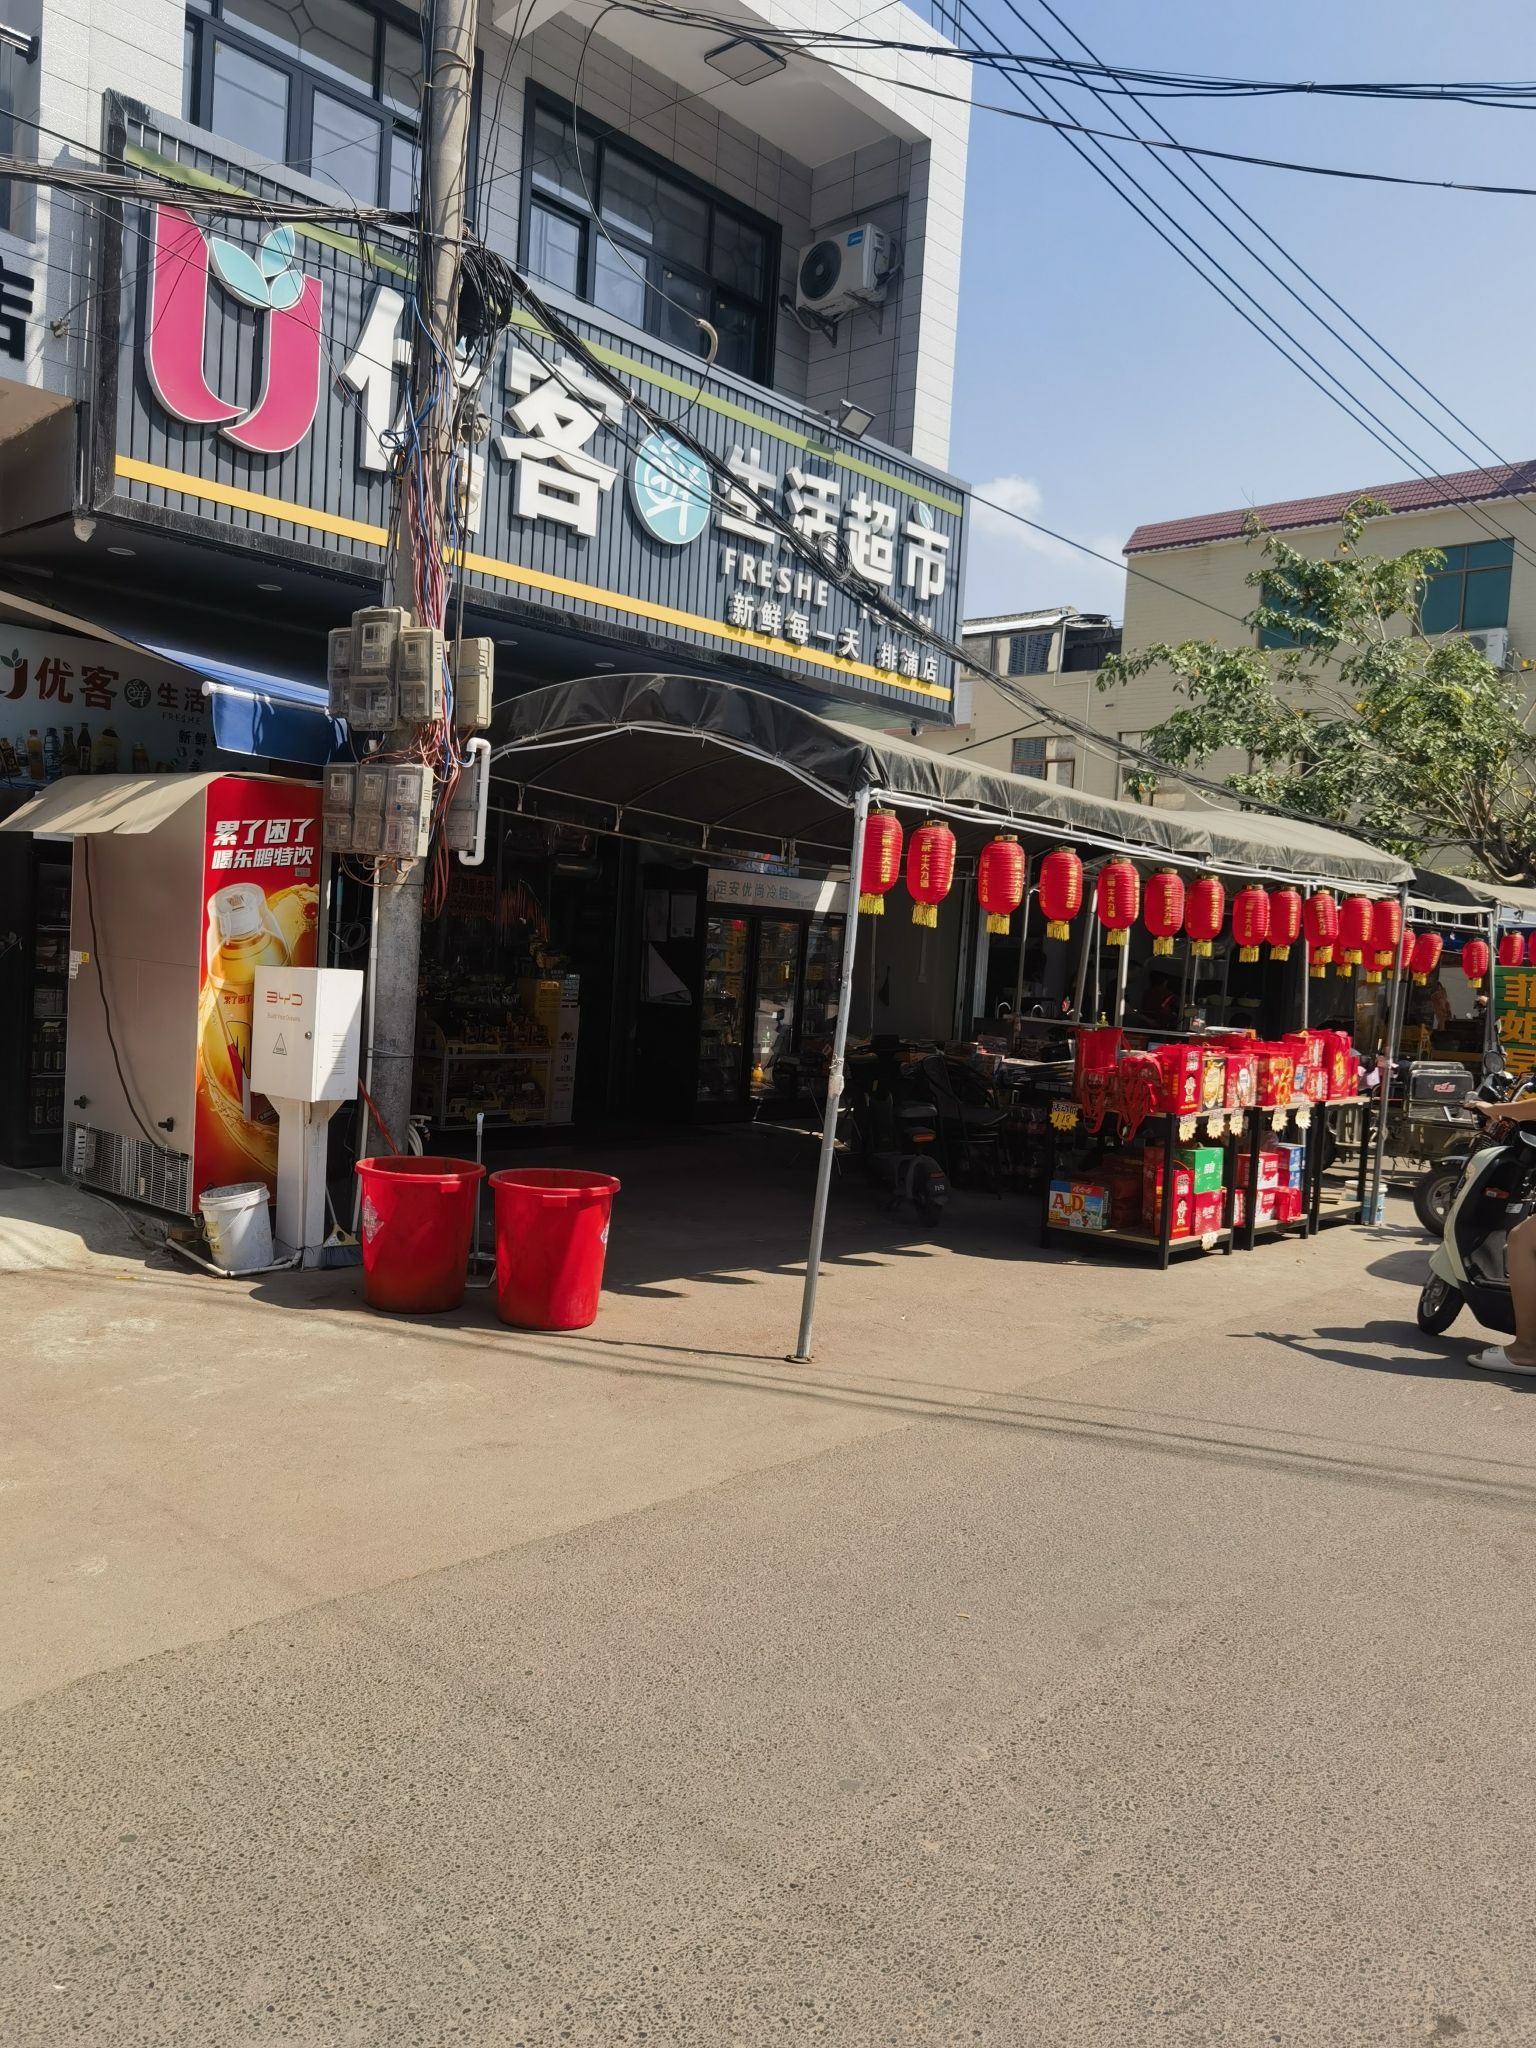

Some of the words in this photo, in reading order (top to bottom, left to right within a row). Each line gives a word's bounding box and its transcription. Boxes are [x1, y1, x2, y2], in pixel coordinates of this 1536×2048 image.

[716, 444, 950, 601] 生活超市
[721, 546, 829, 607] FRESHE
[730, 590, 860, 661] 新鲜每一天
[879, 641, 938, 683] 排浦店
[35, 656, 119, 710] 优客
[211, 847, 314, 869] 喝东鹏特饮
[213, 818, 314, 846] 累了困了
[266, 990, 303, 1006] BYD
